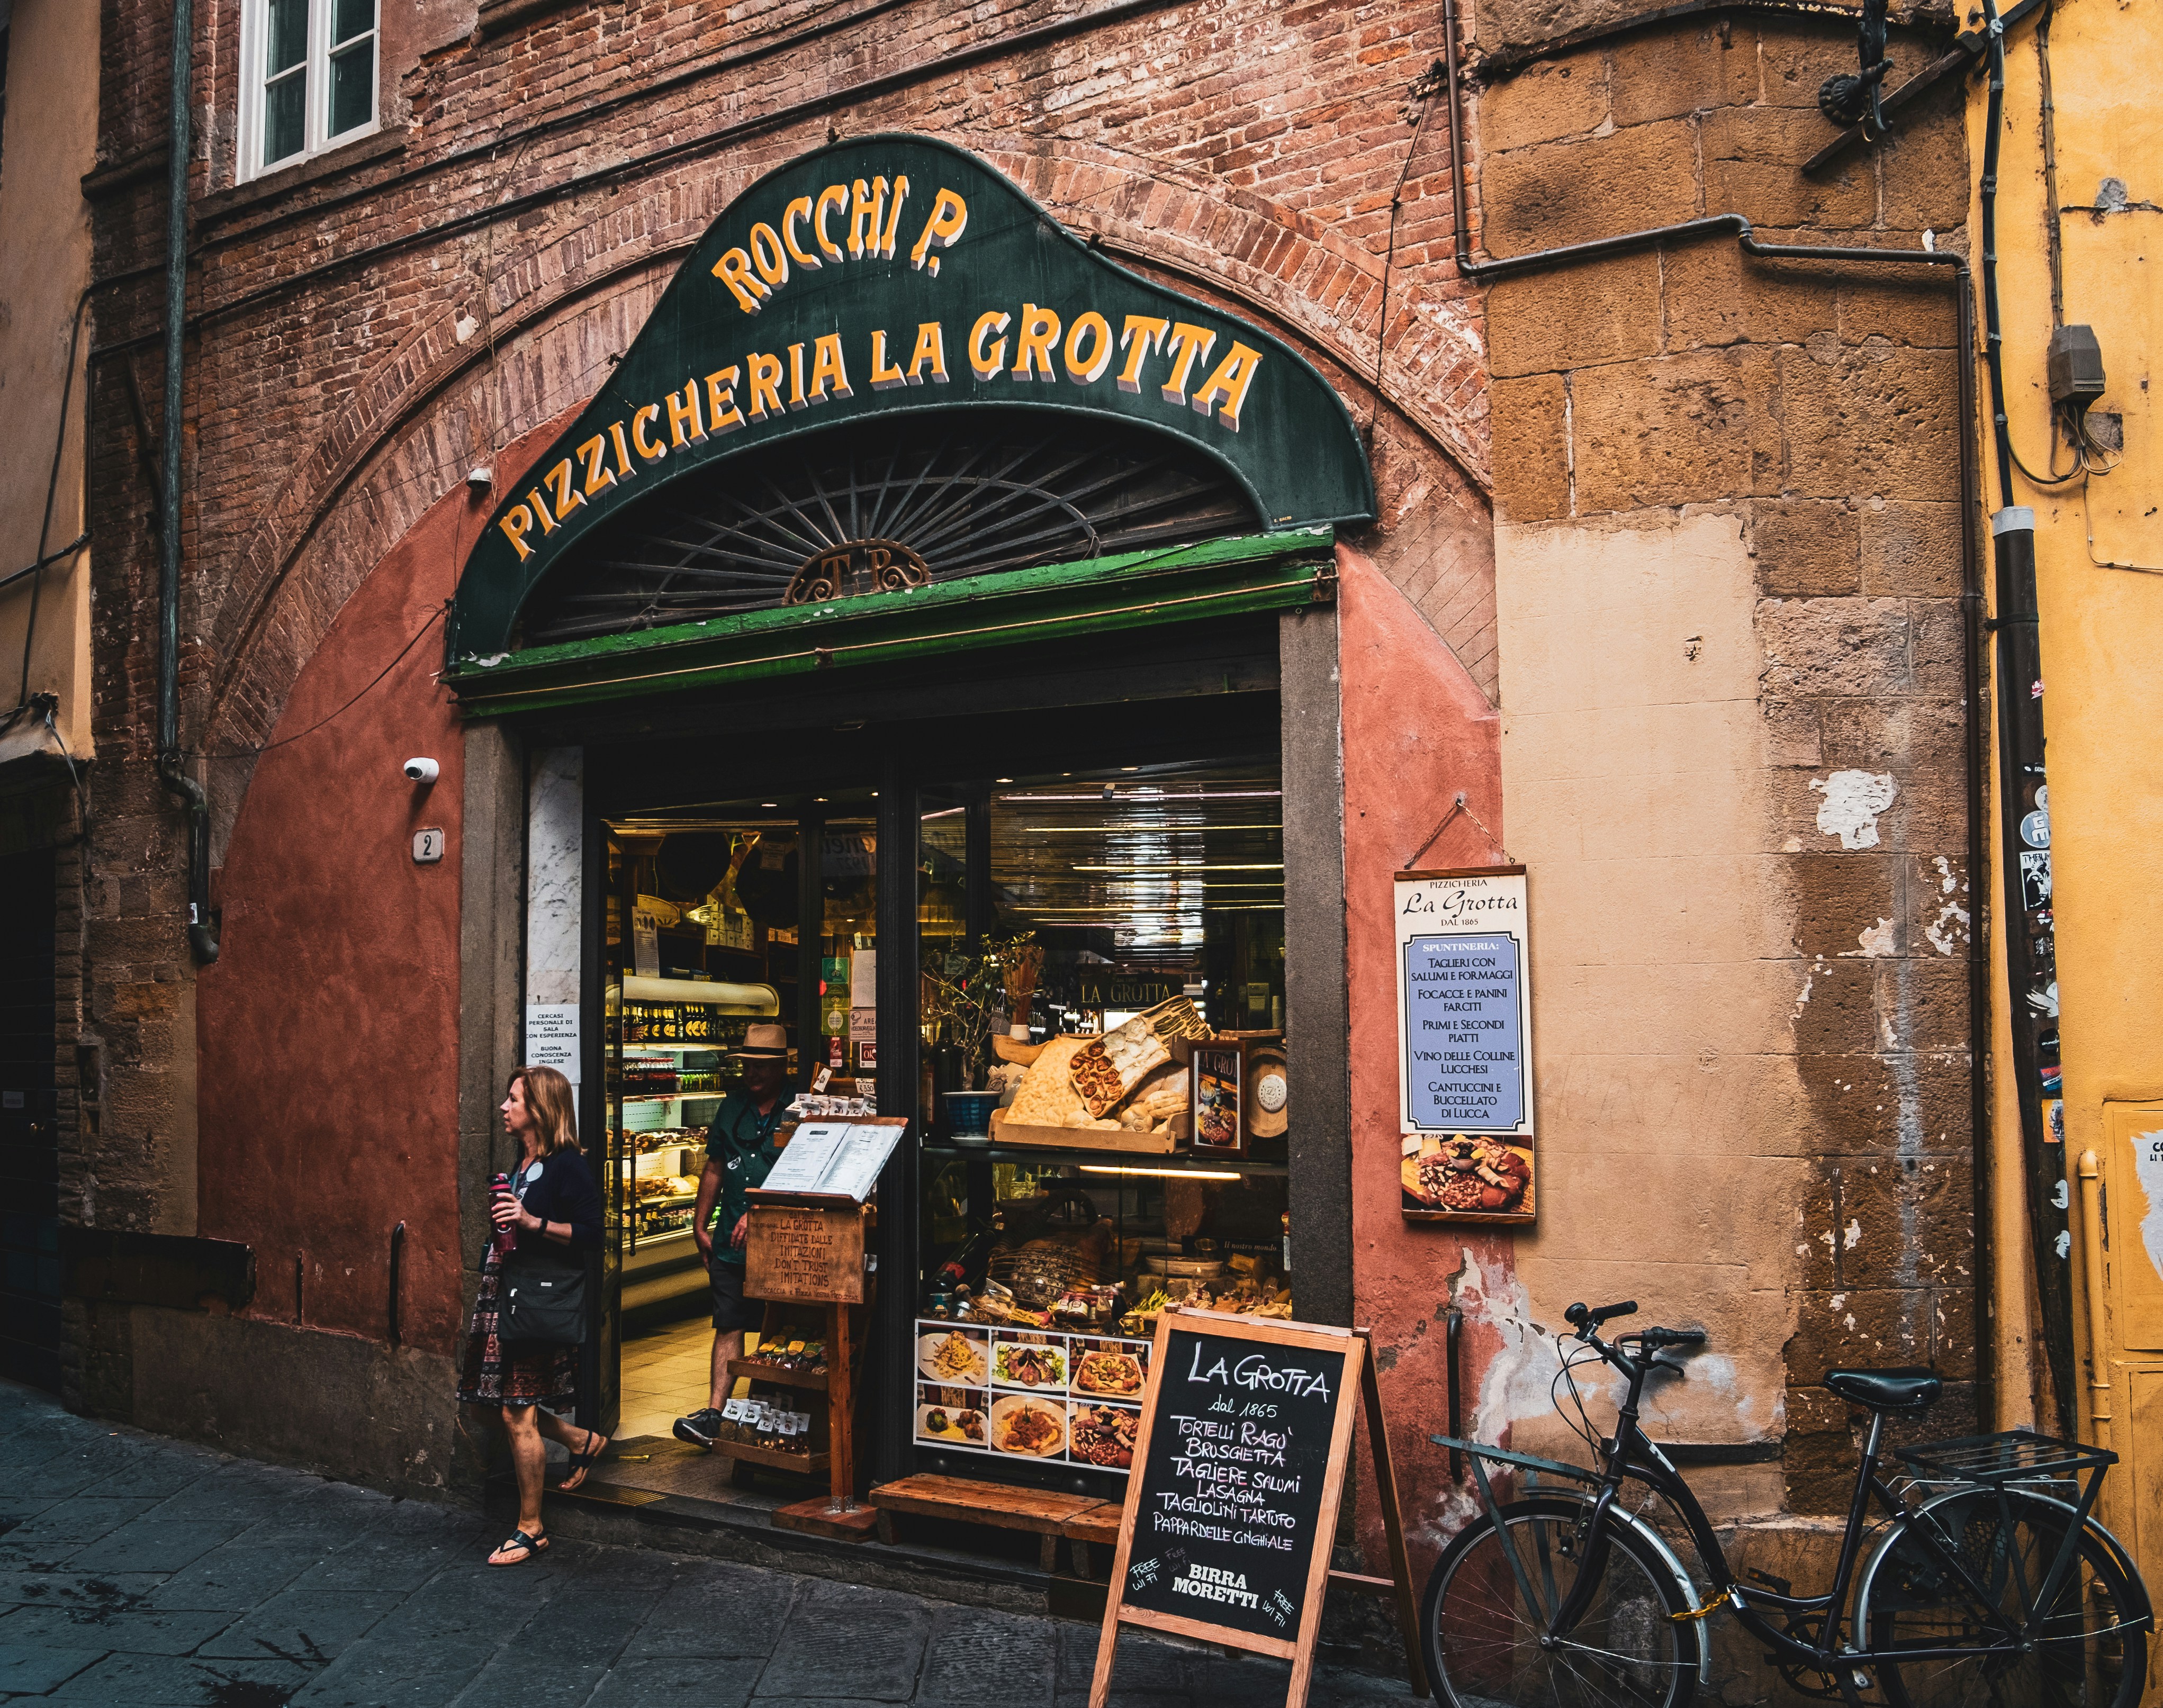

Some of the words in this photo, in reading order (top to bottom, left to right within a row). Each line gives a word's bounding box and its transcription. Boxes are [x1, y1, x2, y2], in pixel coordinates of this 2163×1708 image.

[712, 175, 911, 315] ROCCHI
[911, 188, 968, 277] P.
[498, 332, 853, 562] PIZZICHERIA
[870, 321, 949, 390] LA
[969, 302, 1263, 433] GROTTA
[423, 835, 432, 856] 2
[1430, 879, 1488, 889] PIZZICHERIA
[1403, 892, 1435, 915] La
[1443, 890, 1518, 918] Grotta
[1422, 942, 1499, 952] SPUNTINERIA:
[1428, 958, 1470, 968] TAGLIERI
[1472, 957, 1495, 968] CON
[1411, 972, 1448, 981] SALUMI
[1450, 972, 1456, 980] E
[1458, 970, 1513, 980] FORMAGGI
[1081, 984, 1101, 1003] LA
[1111, 983, 1171, 1002] GROTTA
[1418, 989, 1465, 999] FOCACCE
[1467, 989, 1472, 998] E
[1475, 989, 1507, 998] PANINI
[1444, 1002, 1482, 1011] FARCITI
[1422, 1020, 1450, 1030] PRIMI
[1453, 1021, 1458, 1029] E
[1461, 1019, 1504, 1029] SECONDI
[1448, 1034, 1479, 1043] PIATTI
[1414, 1051, 1442, 1061] VINO
[1444, 1052, 1471, 1061] DELLE
[1473, 1050, 1515, 1061] COLLINE
[1441, 1063, 1488, 1074] LUCCHESI
[1428, 1081, 1494, 1092] CANTUCCINI
[1497, 1083, 1502, 1092] E
[1434, 1095, 1498, 1105] BUCCELLATO
[1441, 1109, 1451, 1118] DI
[1454, 1108, 1490, 1118] LUCCA
[780, 1219, 791, 1230] LA
[794, 1219, 824, 1232] GROTTA
[770, 1232, 808, 1243] DIFFIDATE
[811, 1235, 833, 1245] DALLE
[780, 1245, 826, 1260] IMITAZIONI
[774, 1258, 799, 1270] DON'T
[801, 1260, 828, 1272] TRUST
[1188, 1341, 1228, 1385] LA
[1233, 1354, 1331, 1403] GROTTA
[1208, 1394, 1235, 1413] dal
[1239, 1402, 1278, 1418] 1865
[1197, 1480, 1266, 1506] LASAGNA
[1240, 1508, 1295, 1529] TARTUFO
[1153, 1512, 1233, 1542] PAPPARDELLE
[1189, 1564, 1247, 1589] BIRRA
[1172, 1577, 1259, 1609] MORETTI
